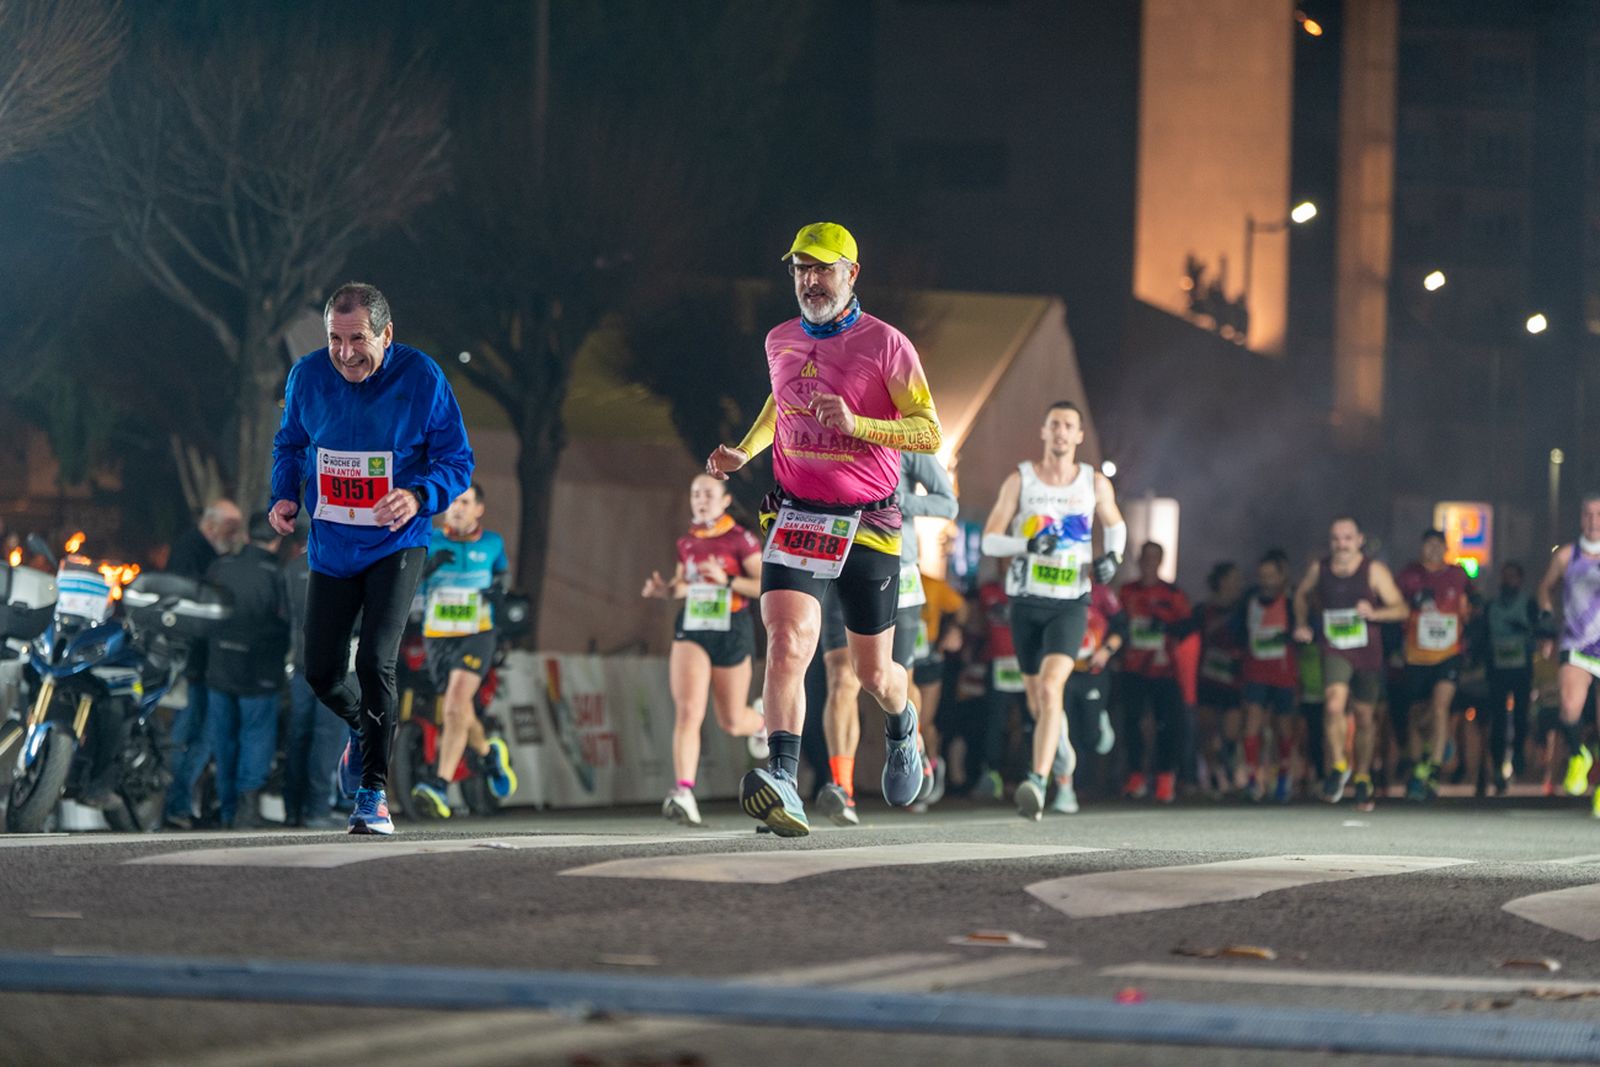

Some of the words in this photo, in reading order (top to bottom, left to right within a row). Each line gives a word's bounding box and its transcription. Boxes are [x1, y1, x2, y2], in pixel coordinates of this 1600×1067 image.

[324, 466, 335, 474] SAN
[330, 459, 350, 467] NOCHE
[352, 459, 361, 468] DE
[332, 477, 374, 500] 9151
[784, 530, 840, 554] 13618
